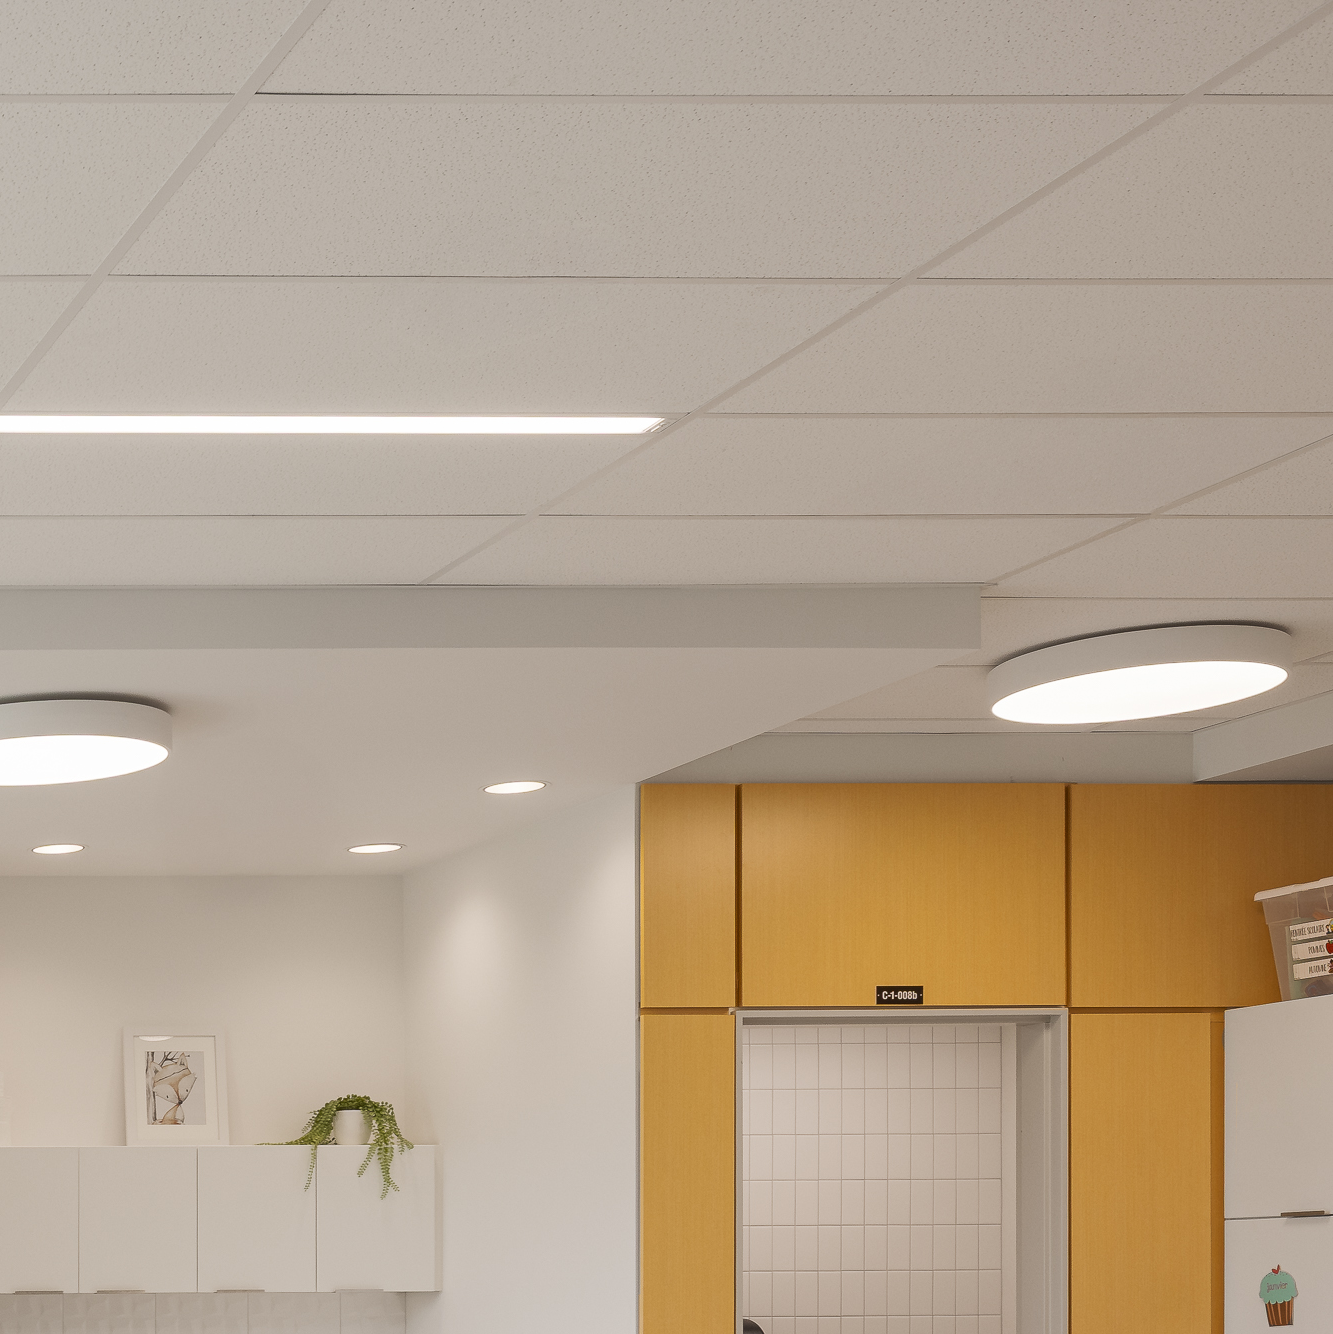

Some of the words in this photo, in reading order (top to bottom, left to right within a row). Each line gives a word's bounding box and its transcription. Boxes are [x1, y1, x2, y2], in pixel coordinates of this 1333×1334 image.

[1308, 945, 1325, 954] POMMES
[882, 990, 918, 1000] C-1-008b
[1266, 1281, 1289, 1293] janvier
